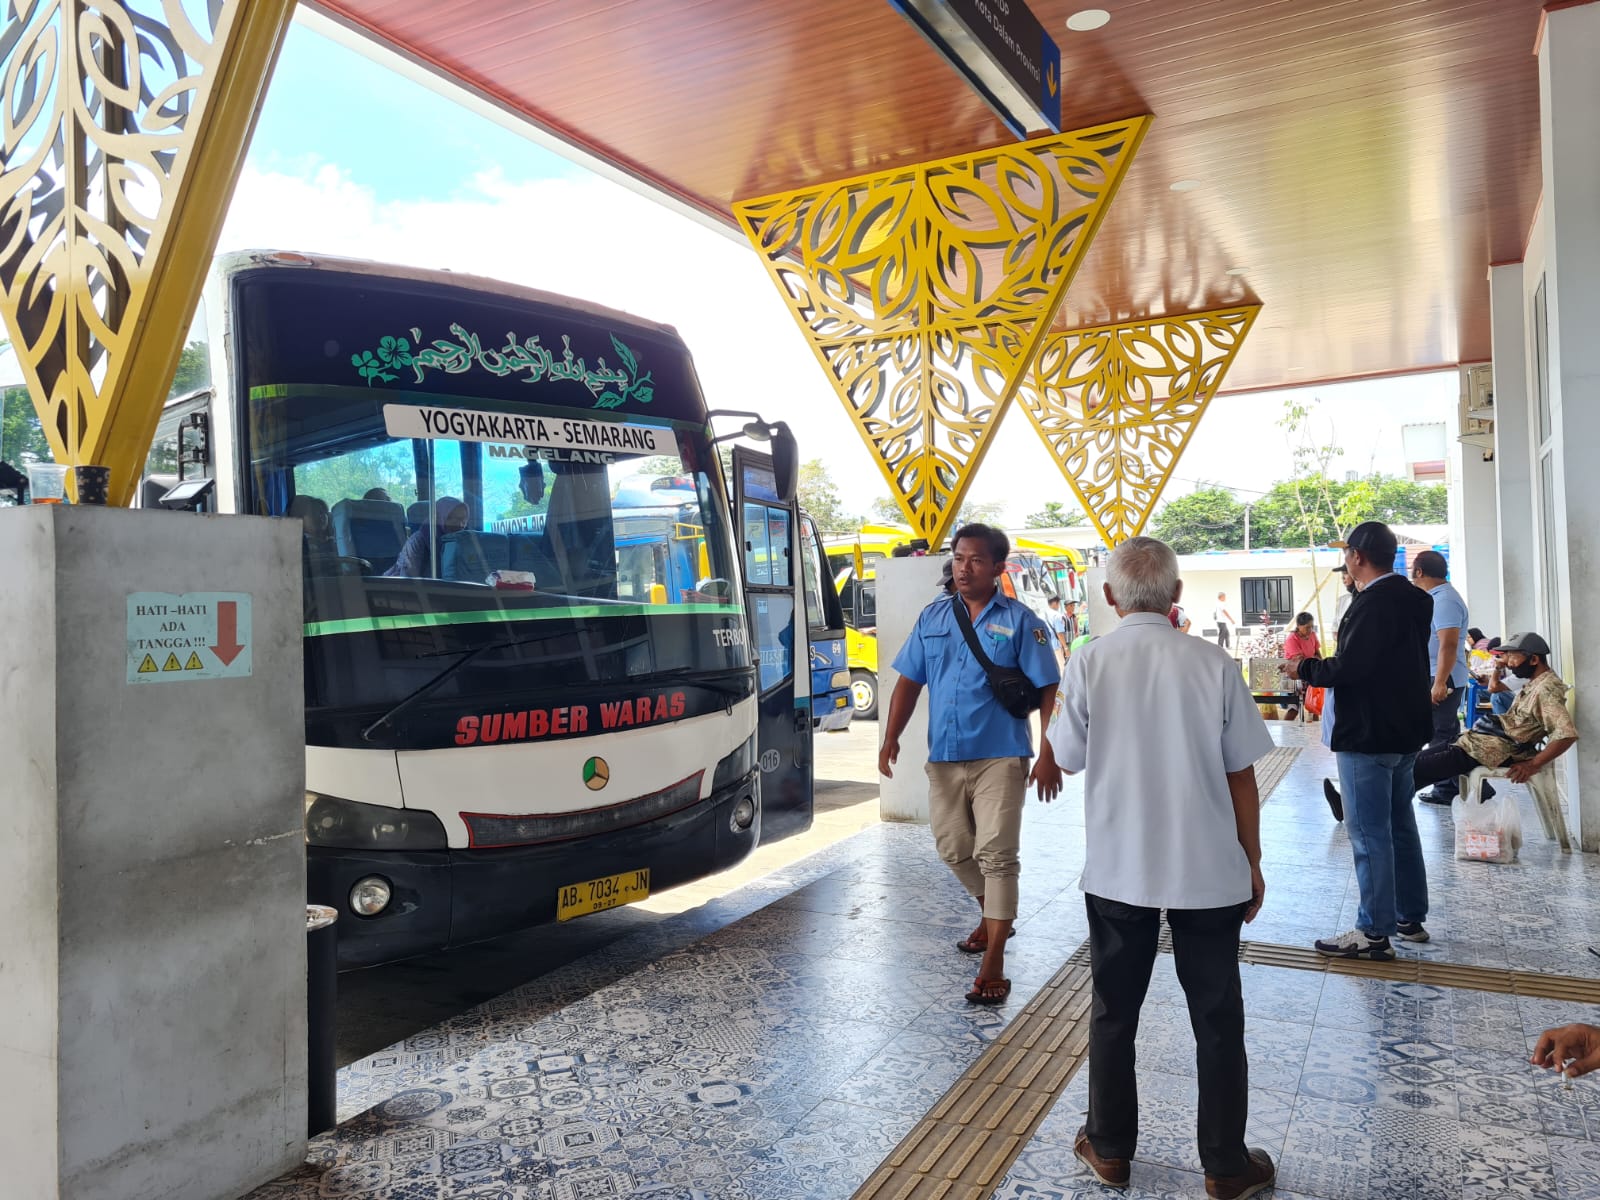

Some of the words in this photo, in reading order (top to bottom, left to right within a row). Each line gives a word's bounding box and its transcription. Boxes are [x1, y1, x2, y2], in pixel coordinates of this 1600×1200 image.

[993, 14, 1015, 52] Dalam
[1016, 43, 1041, 83] Provinsi
[419, 408, 550, 441] YOGYAKARTA
[565, 421, 656, 450] SEMARANG
[489, 445, 616, 465] MAGELANG
[136, 605, 168, 616] HATI
[159, 621, 186, 632] ADA
[455, 705, 589, 744] SUMBER
[600, 691, 686, 729] WARAS
[762, 751, 778, 770] 016
[588, 877, 620, 900] 7034
